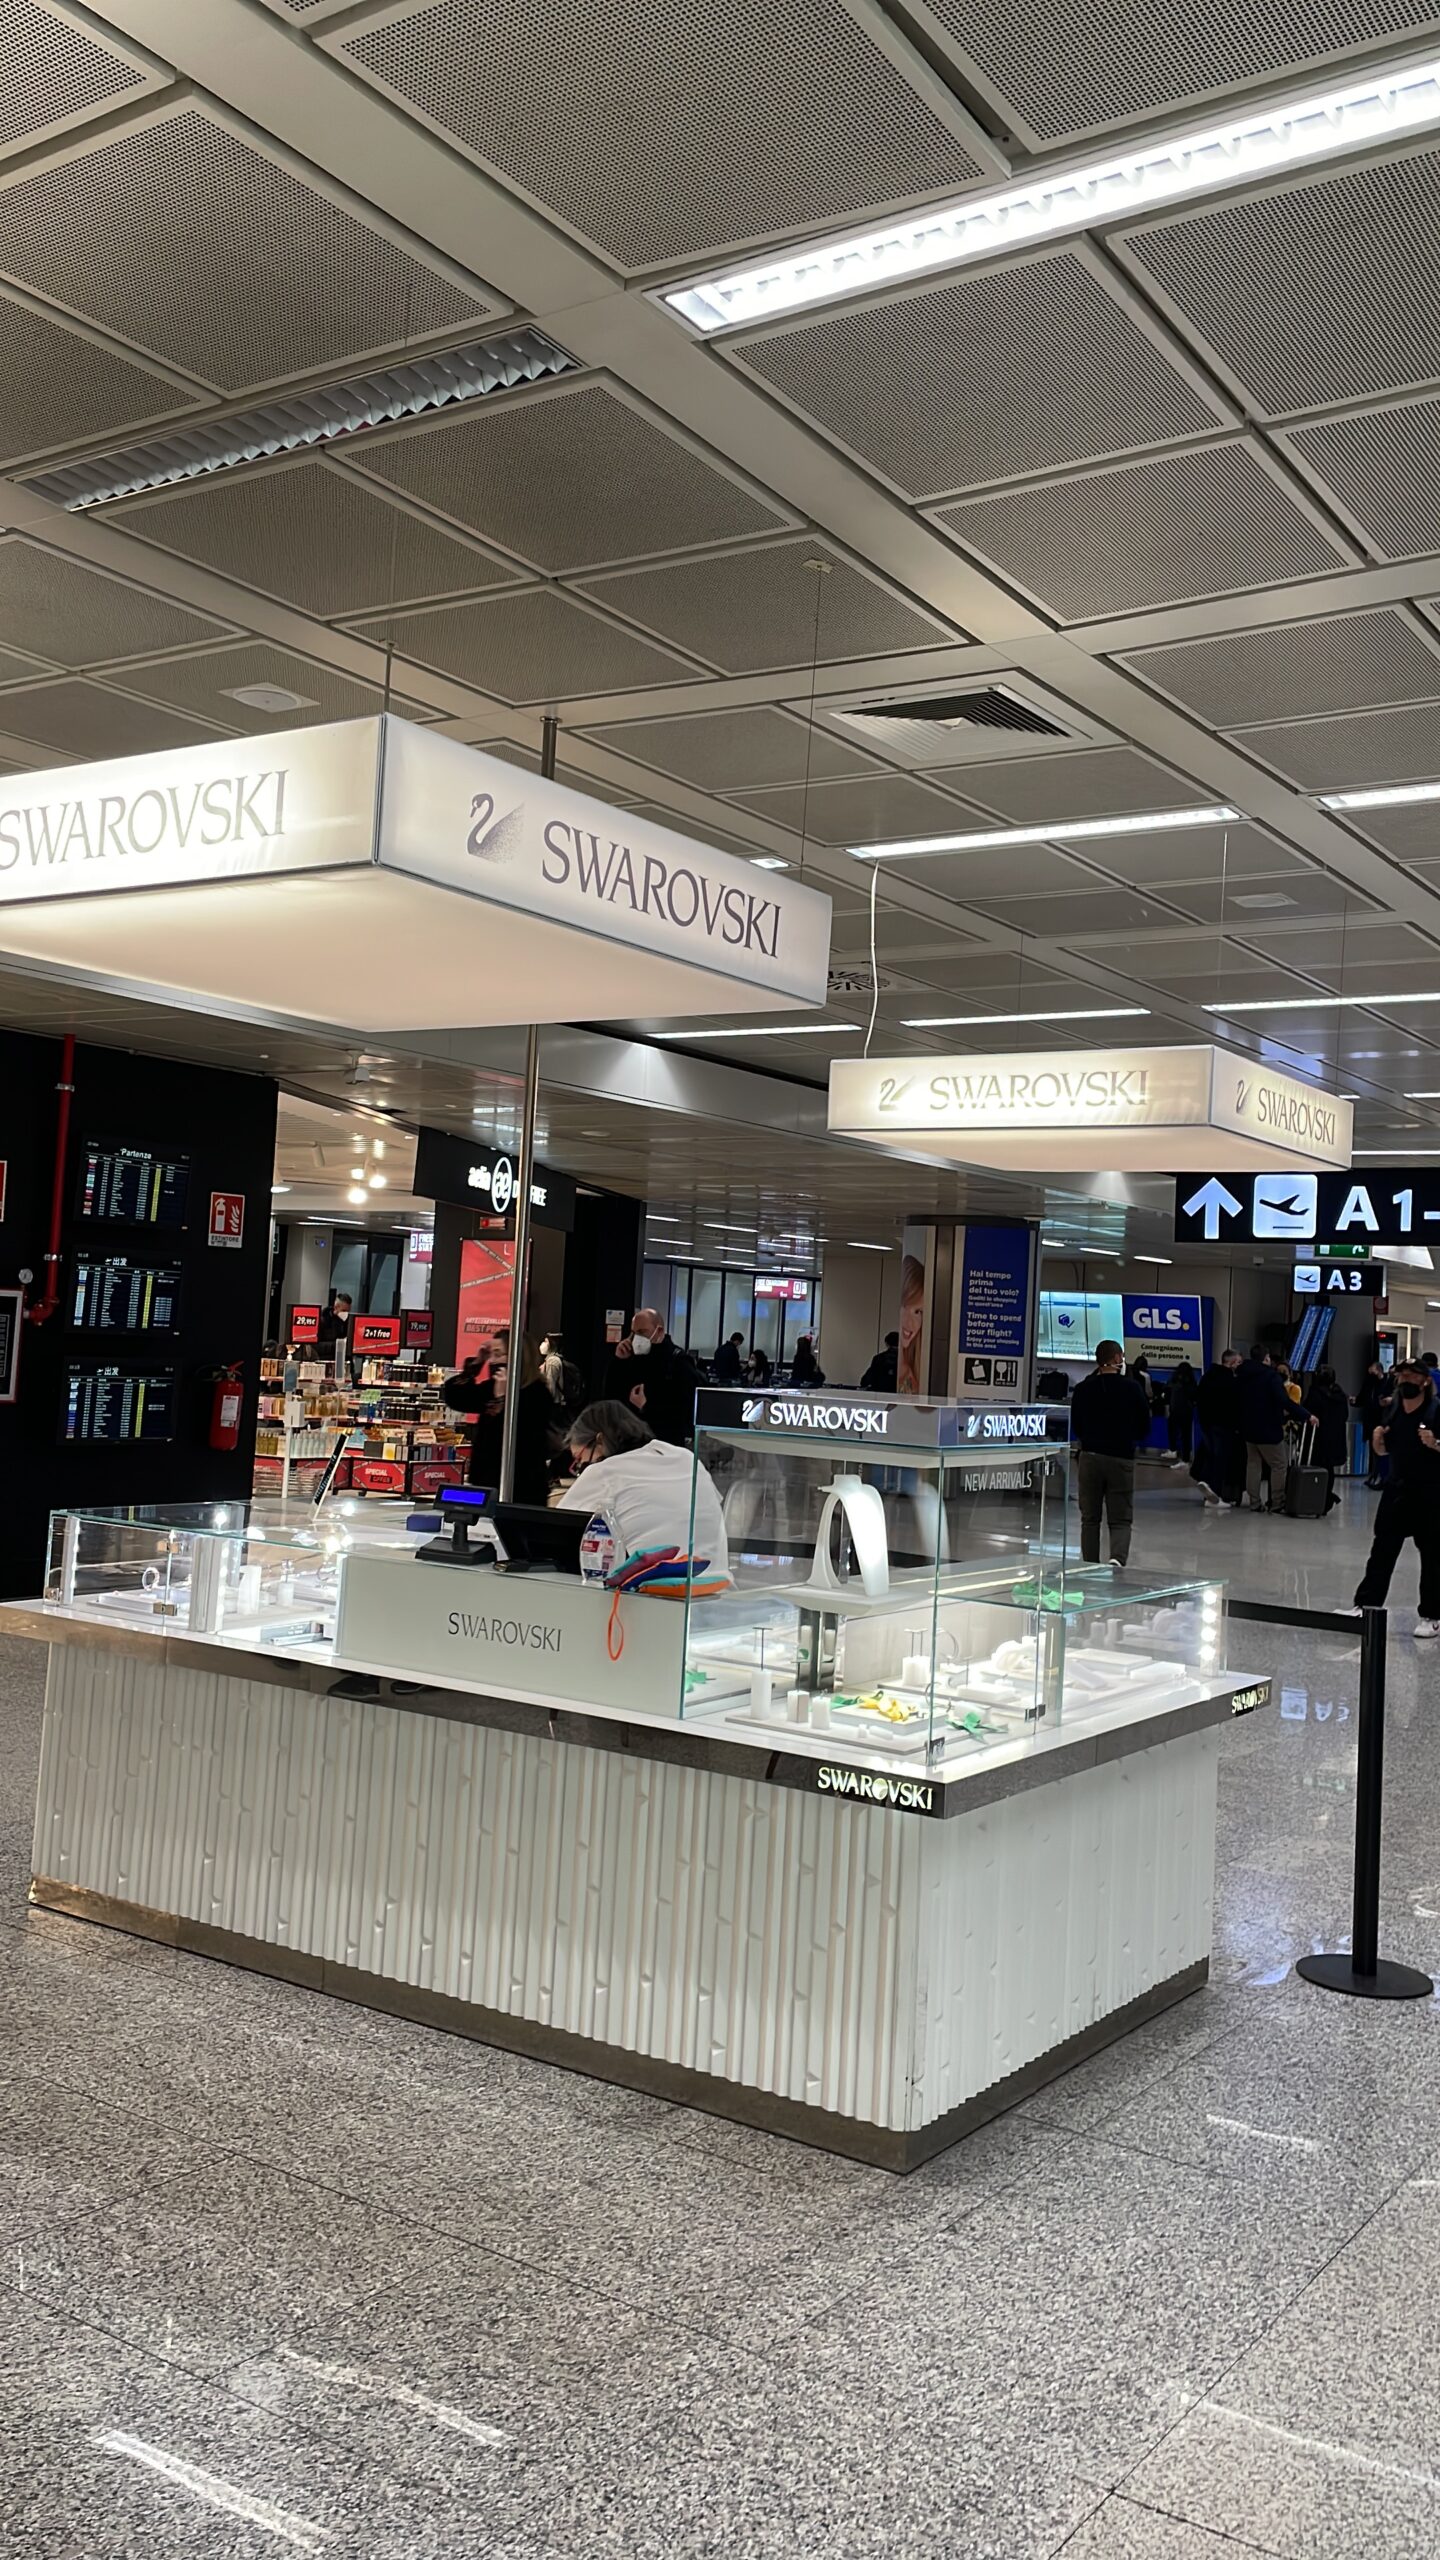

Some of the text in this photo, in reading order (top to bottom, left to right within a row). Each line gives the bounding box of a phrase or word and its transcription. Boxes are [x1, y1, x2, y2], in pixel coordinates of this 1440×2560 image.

[0, 769, 289, 870] SWAROVSKI
[542, 820, 782, 958] SWAROVSKI
[929, 1069, 1149, 1111] SWAROVSKI
[1256, 1087, 1336, 1145] SWAROVSKI
[121, 1148, 152, 1159] Partenze
[969, 1270, 1011, 1280] Hai tempo
[969, 1279, 993, 1287] prima
[968, 1286, 982, 1294] del
[984, 1287, 998, 1295] tuo
[967, 1311, 987, 1319] Time
[1000, 1314, 1022, 1322] spend
[967, 1320, 994, 1328] before
[365, 1328, 391, 1338] 2+1 free
[966, 1328, 1012, 1338] your flight?
[1141, 1343, 1184, 1353] Consegniamo
[770, 1403, 888, 1434] SWAROVSKI
[983, 1414, 1047, 1438] SWAROVSKI
[365, 1467, 388, 1477] SPECIAL
[424, 1471, 446, 1479] SPECIAL
[964, 1470, 1033, 1492] NEW ARRIVALS
[448, 1612, 562, 1652] SWAROVSKI
[817, 1766, 933, 1810] SWAROVSKI
